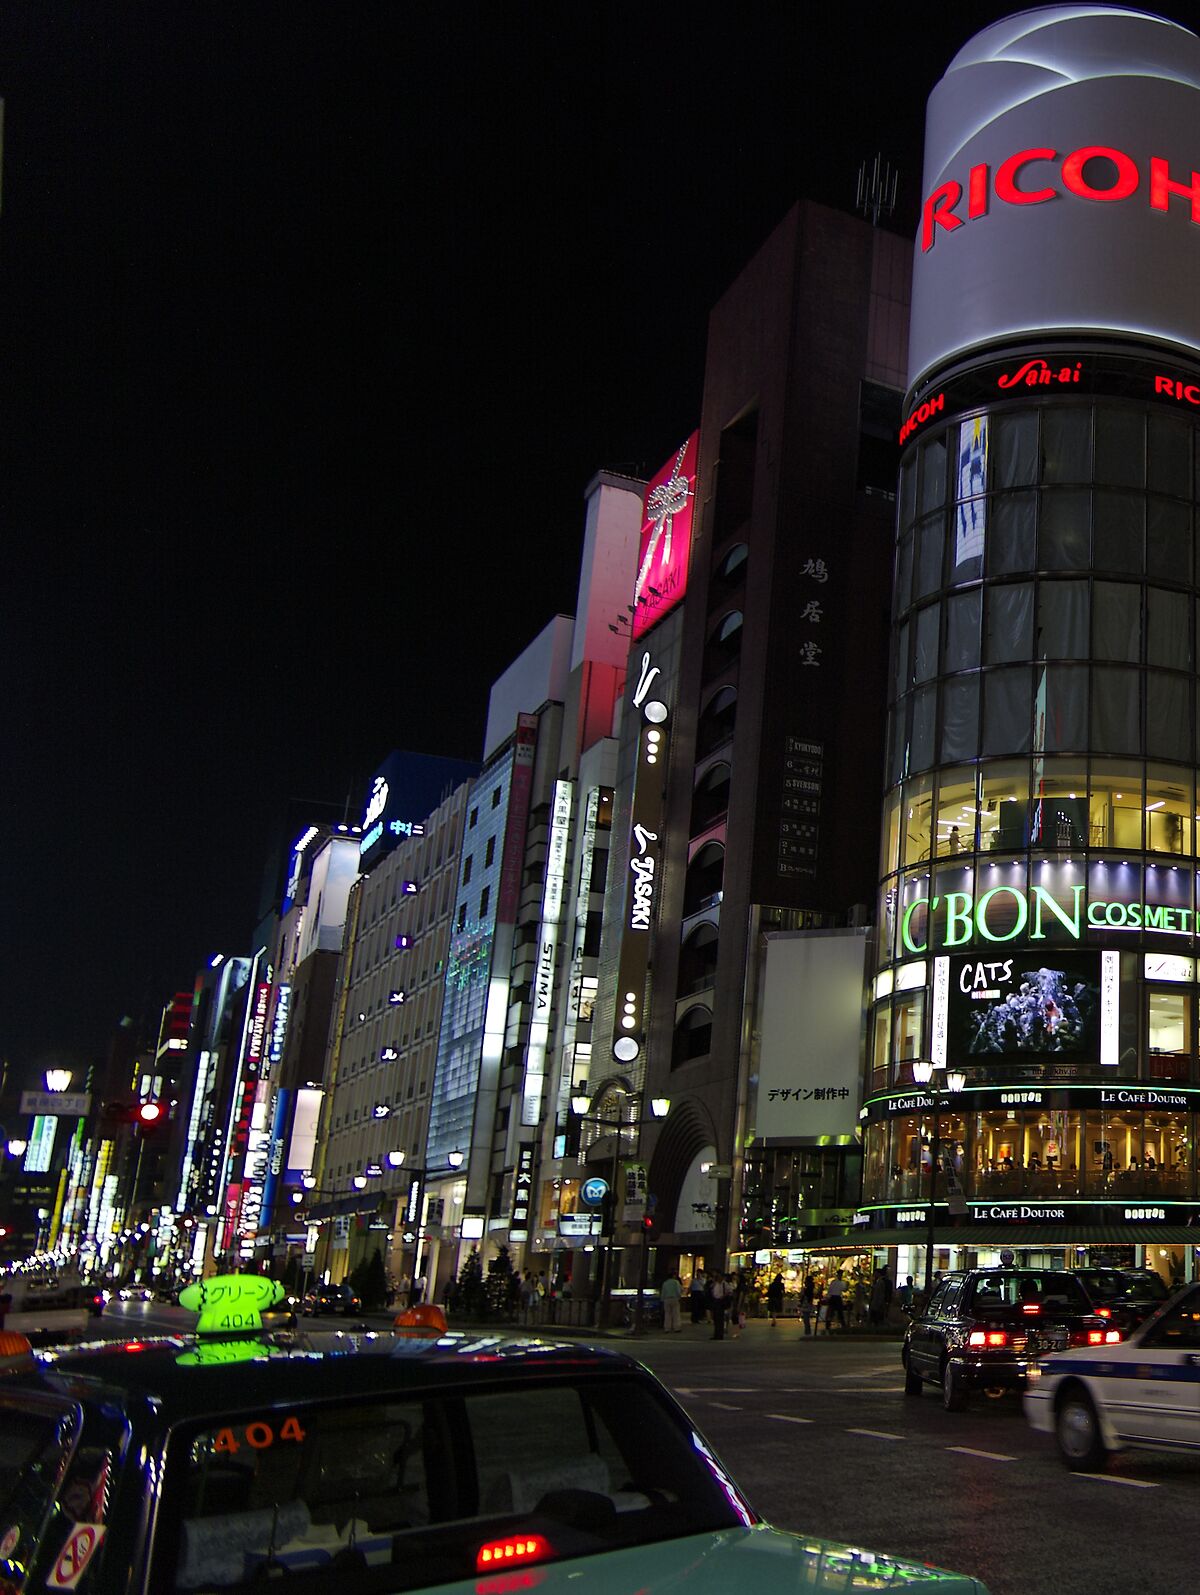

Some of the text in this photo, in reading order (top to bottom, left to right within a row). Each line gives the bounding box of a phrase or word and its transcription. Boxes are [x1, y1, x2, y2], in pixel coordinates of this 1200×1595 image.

[998, 359, 1083, 389] San-ai
[900, 393, 945, 447] RICOH
[799, 558, 829, 668] 鳩居堂
[631, 857, 655, 930] TASAKI
[902, 885, 1086, 953] C'BON
[537, 942, 553, 1010] SHIMA
[959, 958, 1013, 994] CATS
[767, 1088, 850, 1102] デザイン制作中
[209, 1284, 273, 1305] グリーン
[220, 1313, 255, 1329] 404
[213, 1416, 306, 1455] 404
